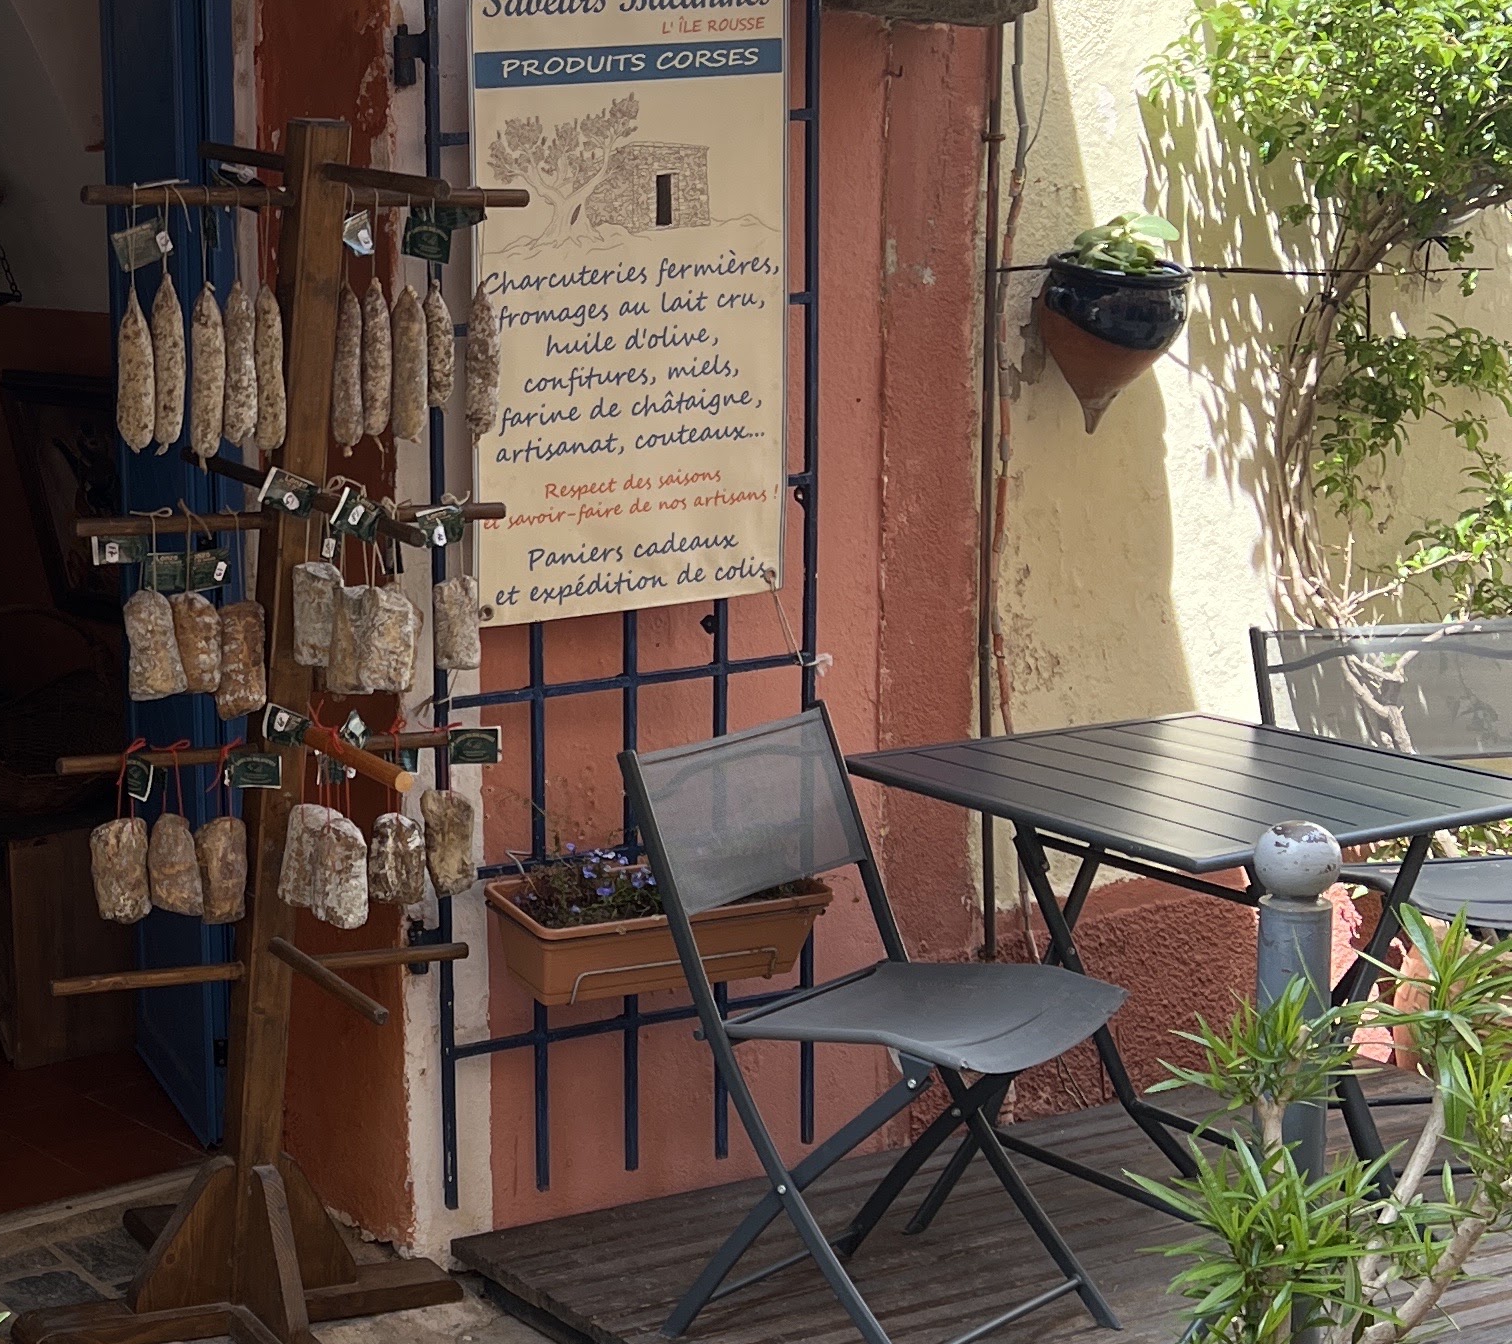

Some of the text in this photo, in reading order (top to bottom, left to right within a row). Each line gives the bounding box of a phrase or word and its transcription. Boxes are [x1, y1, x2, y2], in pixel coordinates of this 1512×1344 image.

[678, 15, 702, 34] ÎLE
[707, 16, 766, 33] ROUSSE
[501, 47, 760, 79] PRODUITS CORSES
[485, 249, 780, 297] Charcuteries fermières,
[498, 289, 767, 333] fromages au lait cru,
[545, 324, 721, 357] huile d'olive,
[523, 354, 740, 398] confitures, miels,
[498, 388, 764, 438] farine de châtaigne,
[495, 422, 766, 465] artisanat, couteaux...
[544, 467, 723, 501] Respect des saisons
[507, 502, 624, 530] savoir-faire
[628, 493, 653, 514] de
[657, 496, 688, 512] nos
[693, 488, 768, 508] artisans
[527, 532, 740, 572] Paniers cadeaux
[495, 556, 767, 608] et expédition de colis
